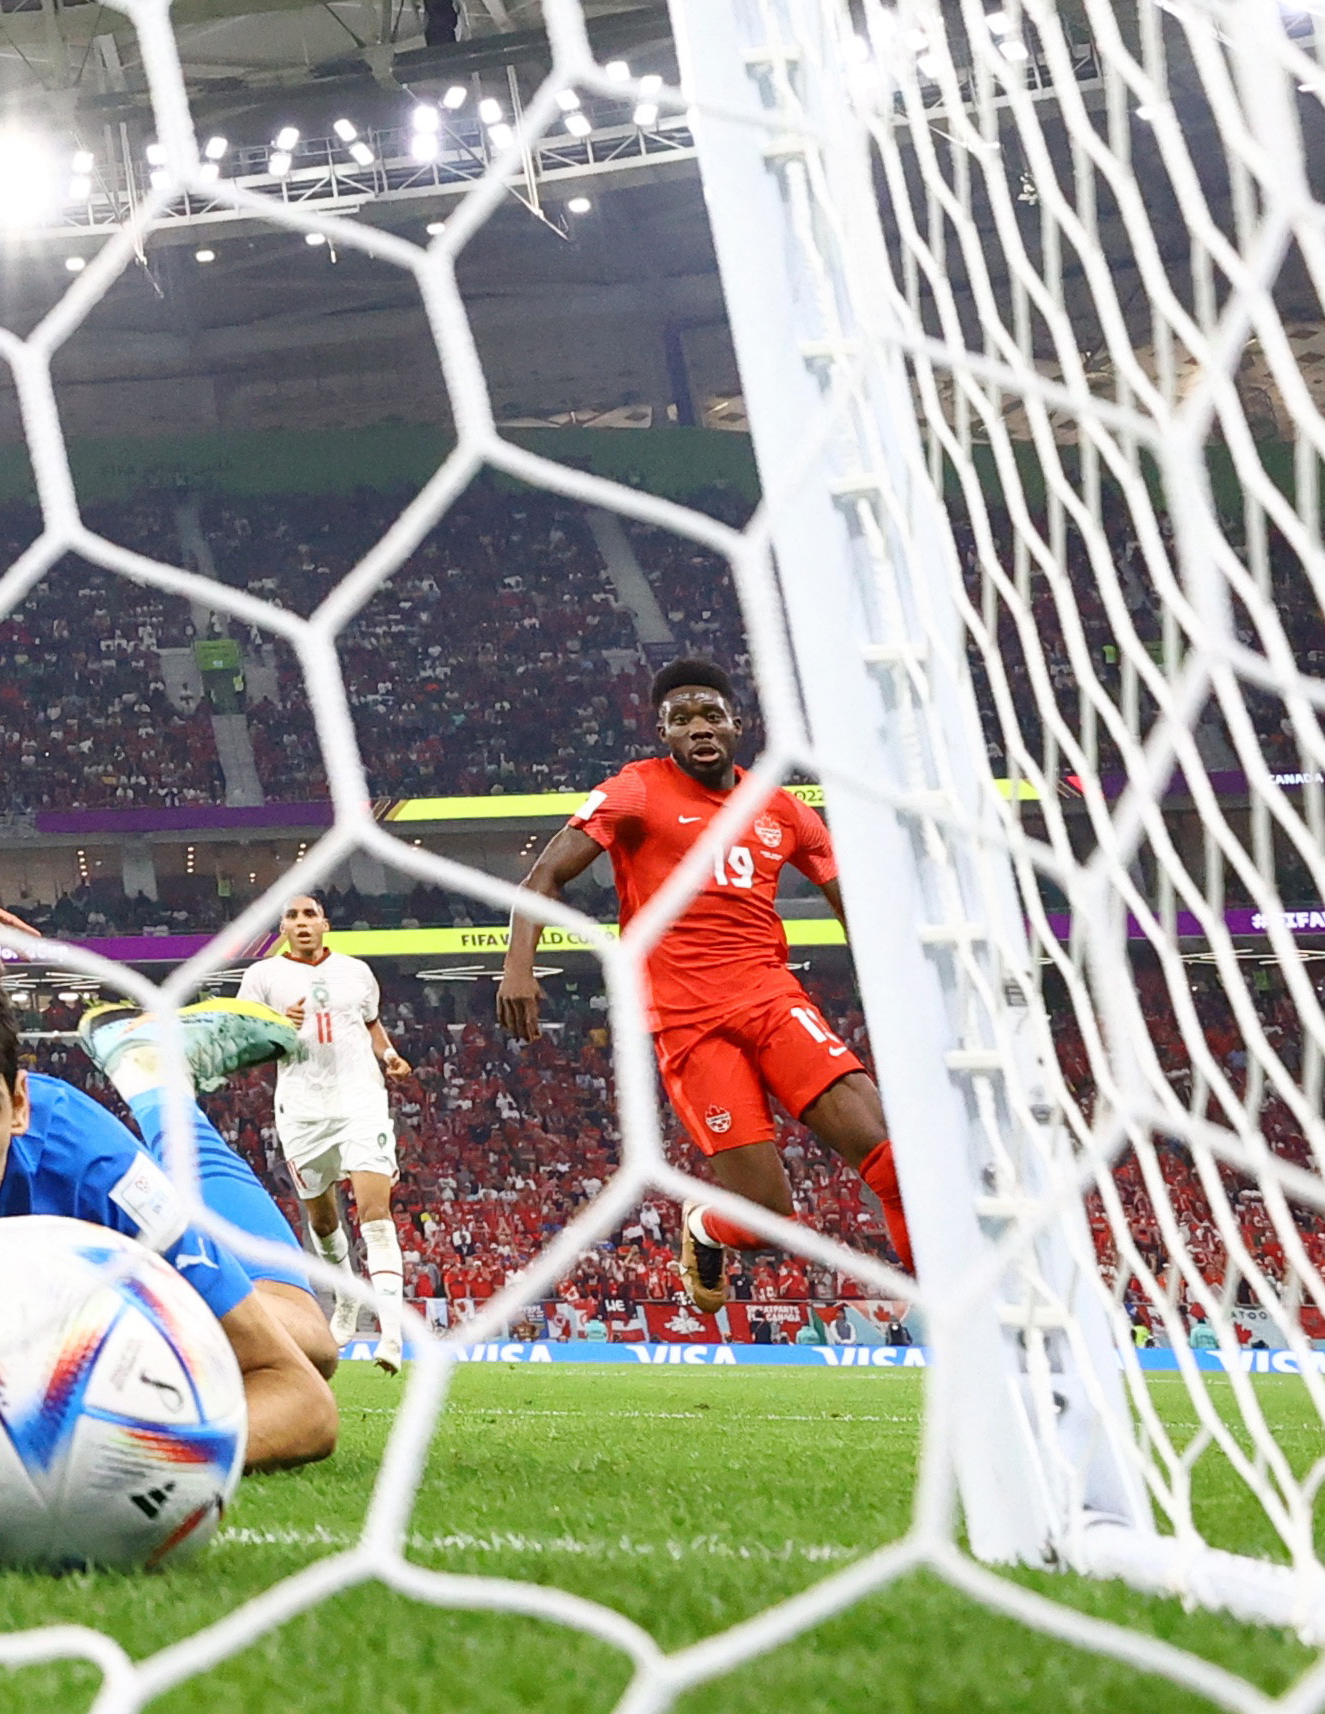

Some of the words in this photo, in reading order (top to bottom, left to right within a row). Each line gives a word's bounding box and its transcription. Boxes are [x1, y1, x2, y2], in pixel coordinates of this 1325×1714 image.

[710, 845, 755, 888] 19
[461, 932, 498, 946] FIFA
[316, 1012, 333, 1044] 11
[626, 1344, 738, 1365] VISA
[812, 1346, 927, 1367] VISA
